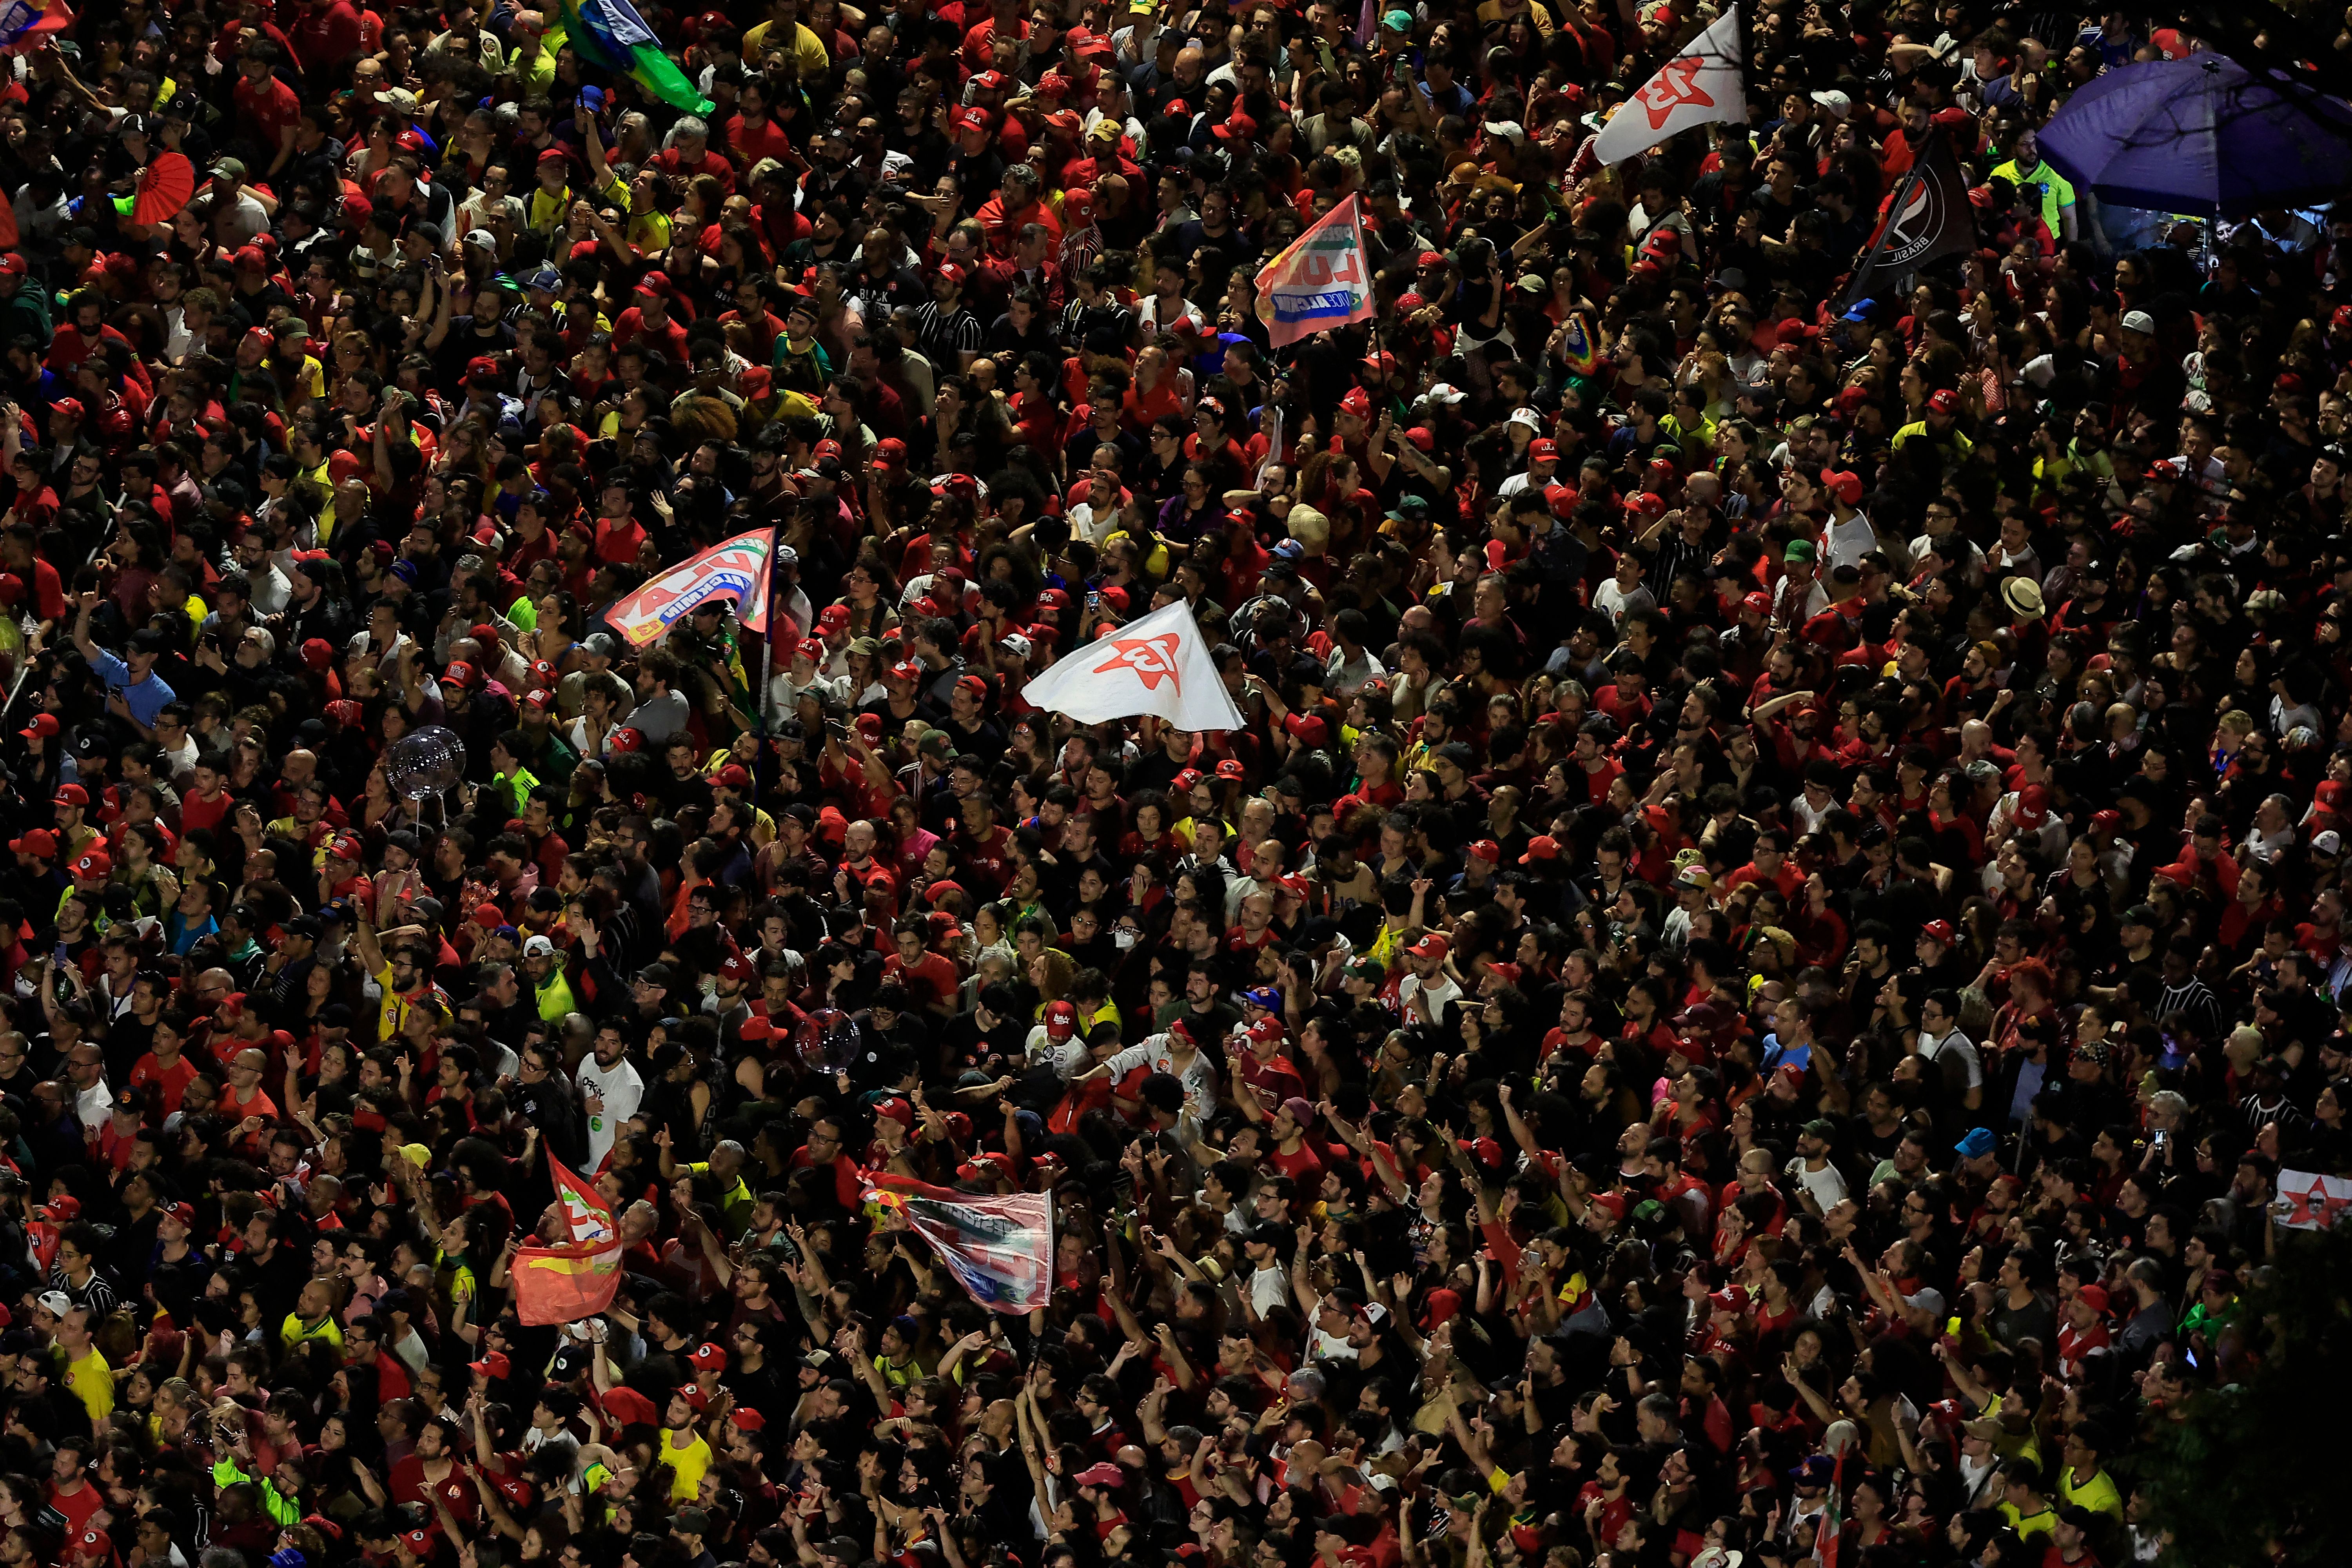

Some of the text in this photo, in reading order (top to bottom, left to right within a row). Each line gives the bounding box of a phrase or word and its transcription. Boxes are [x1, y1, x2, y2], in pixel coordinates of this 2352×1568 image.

[965, 113, 981, 124] LULA
[1934, 394, 1949, 404] LULA
[798, 642, 813, 651] LULA
[1181, 771, 1196, 784] LULA
